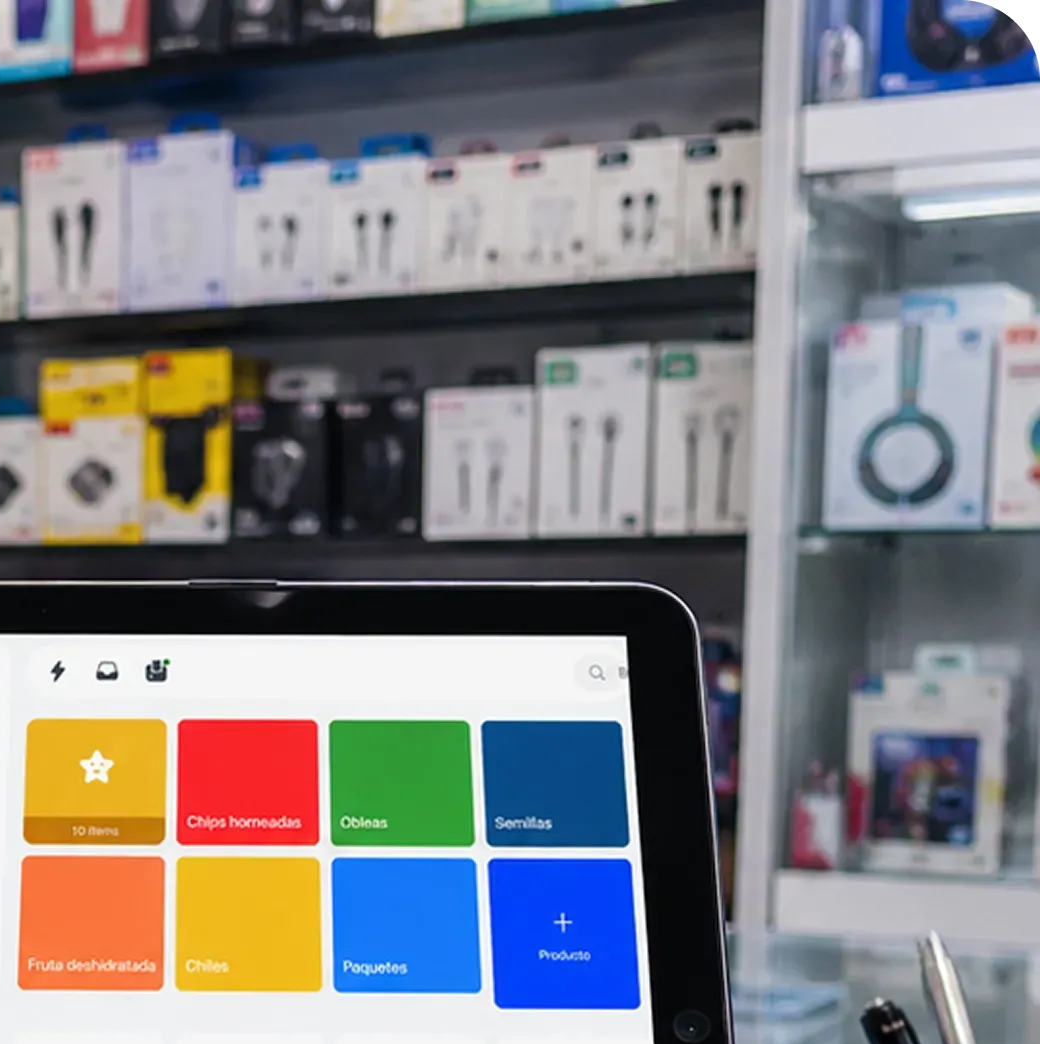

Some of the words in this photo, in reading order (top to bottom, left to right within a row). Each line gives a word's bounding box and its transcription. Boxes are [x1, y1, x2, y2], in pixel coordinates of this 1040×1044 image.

[186, 815, 227, 830] Chips
[229, 815, 302, 829] horneadas
[339, 815, 388, 830] Obleas
[494, 815, 553, 831] Semillas
[538, 948, 592, 961] Producto
[27, 957, 64, 972] Fruta
[66, 958, 157, 973] deshidratada
[185, 958, 230, 974] Chiles
[342, 959, 408, 976] Paquetes
